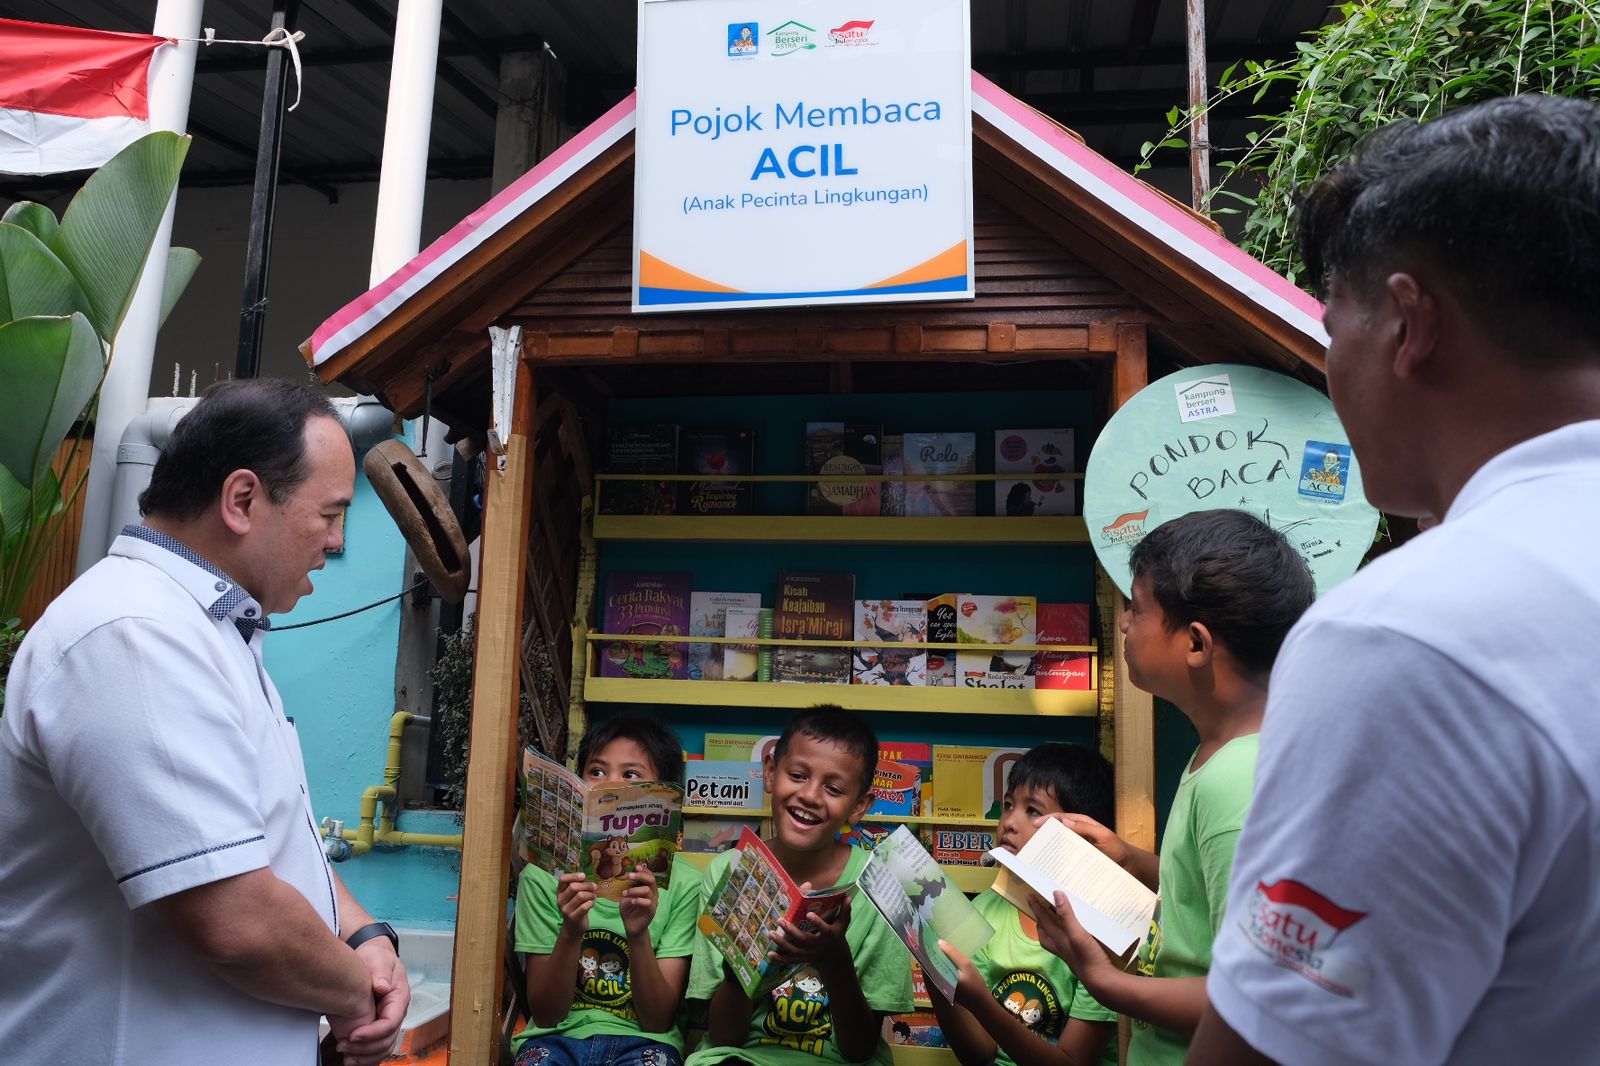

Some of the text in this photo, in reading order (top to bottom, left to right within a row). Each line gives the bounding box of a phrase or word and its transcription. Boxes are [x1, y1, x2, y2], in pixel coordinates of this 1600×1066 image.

[775, 33, 807, 44] Berseri
[670, 98, 941, 140] Pojok Membaca
[750, 143, 858, 181] ACIL
[682, 184, 929, 215] (Anak Pecinta Lingkungan)
[1184, 386, 1226, 403] kampung
[1186, 397, 1217, 410] berseri
[1187, 405, 1219, 418] ASTRA
[920, 443, 959, 463] Rela
[1129, 417, 1290, 501] PONDOK
[823, 463, 862, 473] RENUNGAN
[1186, 459, 1292, 500] BACA
[1306, 482, 1338, 493] ACC
[690, 495, 737, 513] Romance
[1109, 530, 1148, 544] Indonesia
[1112, 523, 1142, 537] satu
[609, 588, 685, 609] Cerita Rakyat
[783, 584, 808, 597] Kisah
[635, 603, 671, 617] Provinsi
[782, 598, 826, 614] Keajaiban
[937, 607, 954, 620] Yes
[872, 777, 894, 789] MAR
[874, 769, 903, 781] PINTAR
[686, 779, 749, 799] Petani
[707, 799, 743, 807] Bermanfaat
[599, 809, 670, 835] Tupai
[937, 831, 995, 851] EBER
[582, 931, 611, 941] CINTA
[585, 977, 625, 996] ACIL
[997, 972, 1036, 994] PENCINTA
[776, 996, 822, 1026] ACIL
